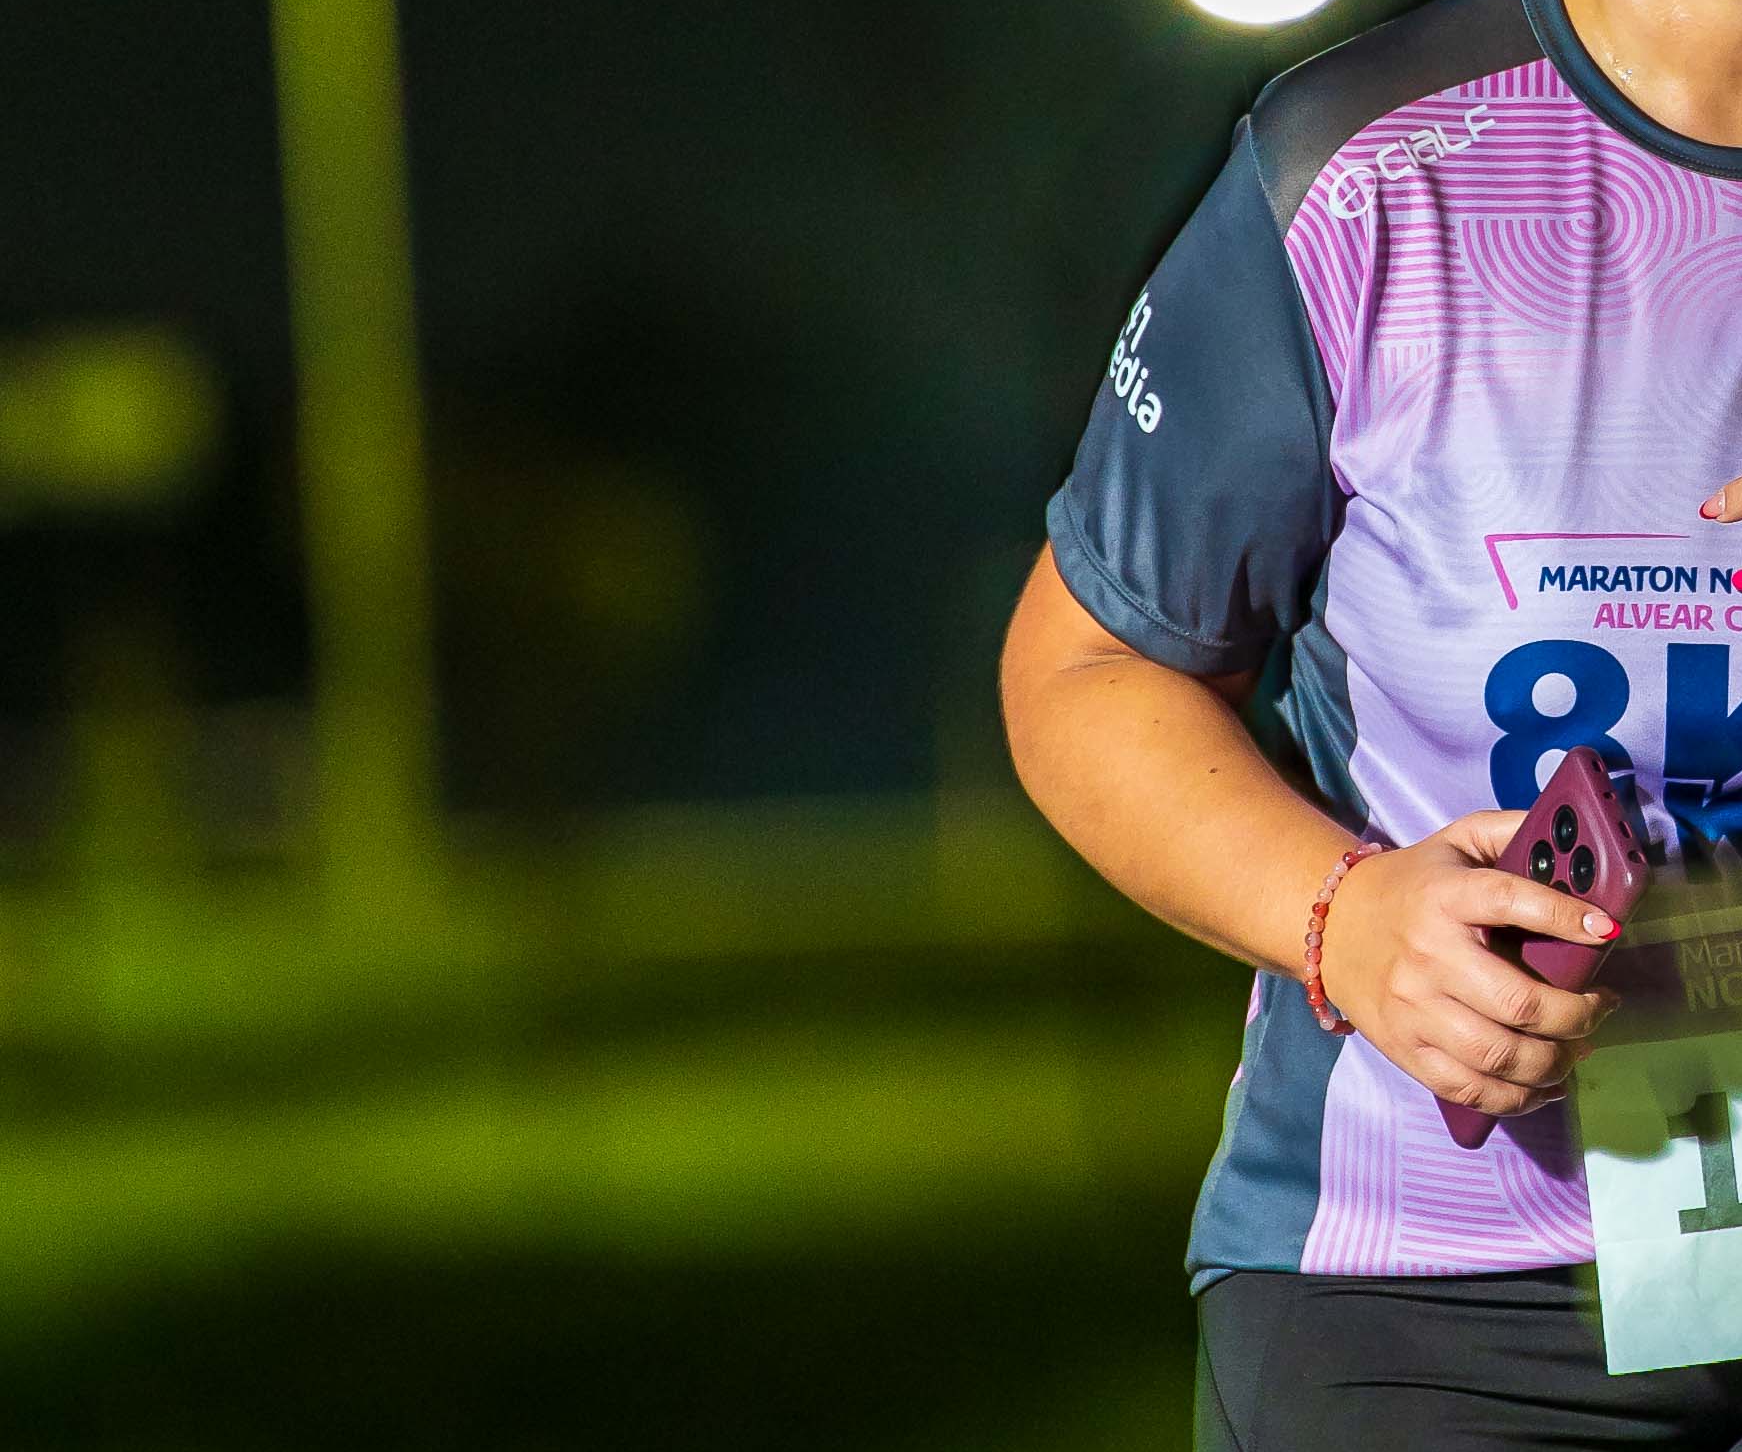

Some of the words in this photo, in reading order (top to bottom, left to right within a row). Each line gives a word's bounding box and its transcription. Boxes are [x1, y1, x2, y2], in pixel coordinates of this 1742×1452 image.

[1109, 326, 1162, 433] edia
[1538, 565, 1698, 593] MARATON
[1593, 602, 1715, 632] ALVEAR
